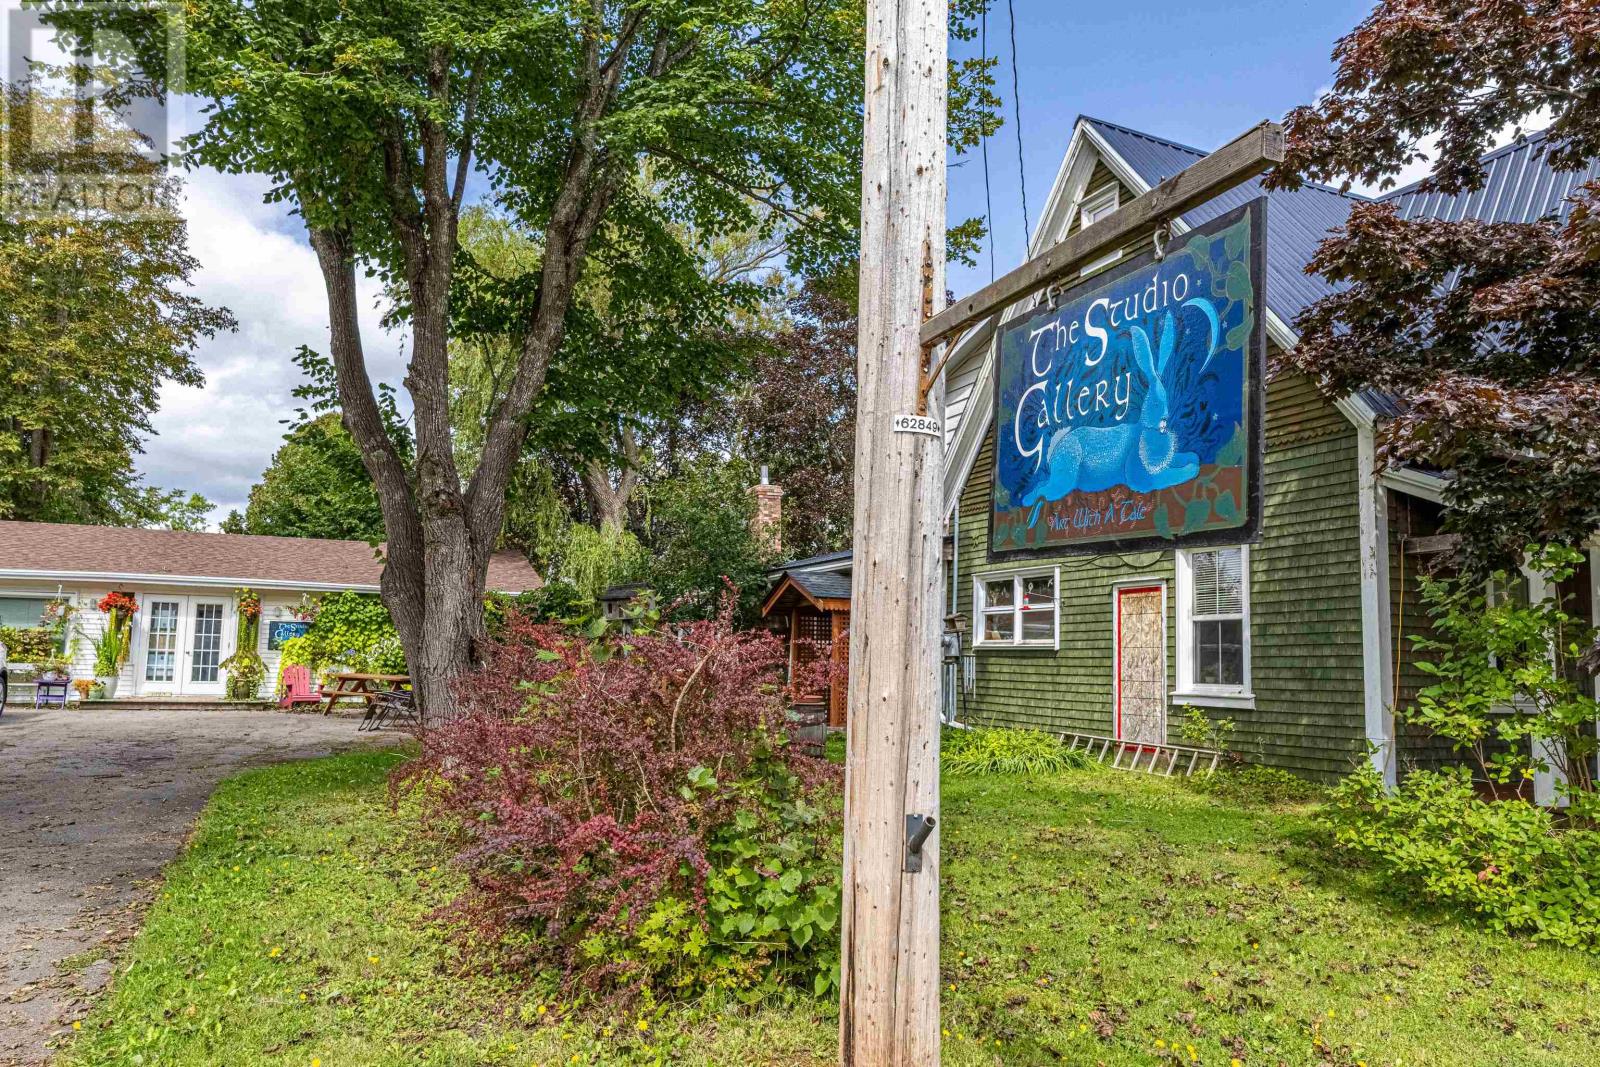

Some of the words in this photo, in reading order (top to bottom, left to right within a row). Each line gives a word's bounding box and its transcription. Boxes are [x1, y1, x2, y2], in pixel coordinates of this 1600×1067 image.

[1028, 317, 1079, 378] The
[1084, 273, 1188, 366] Studio
[901, 418, 938, 432] 62849
[1014, 372, 1131, 473] Gallery
[1073, 507, 1101, 528] With
[1104, 502, 1114, 525] A
